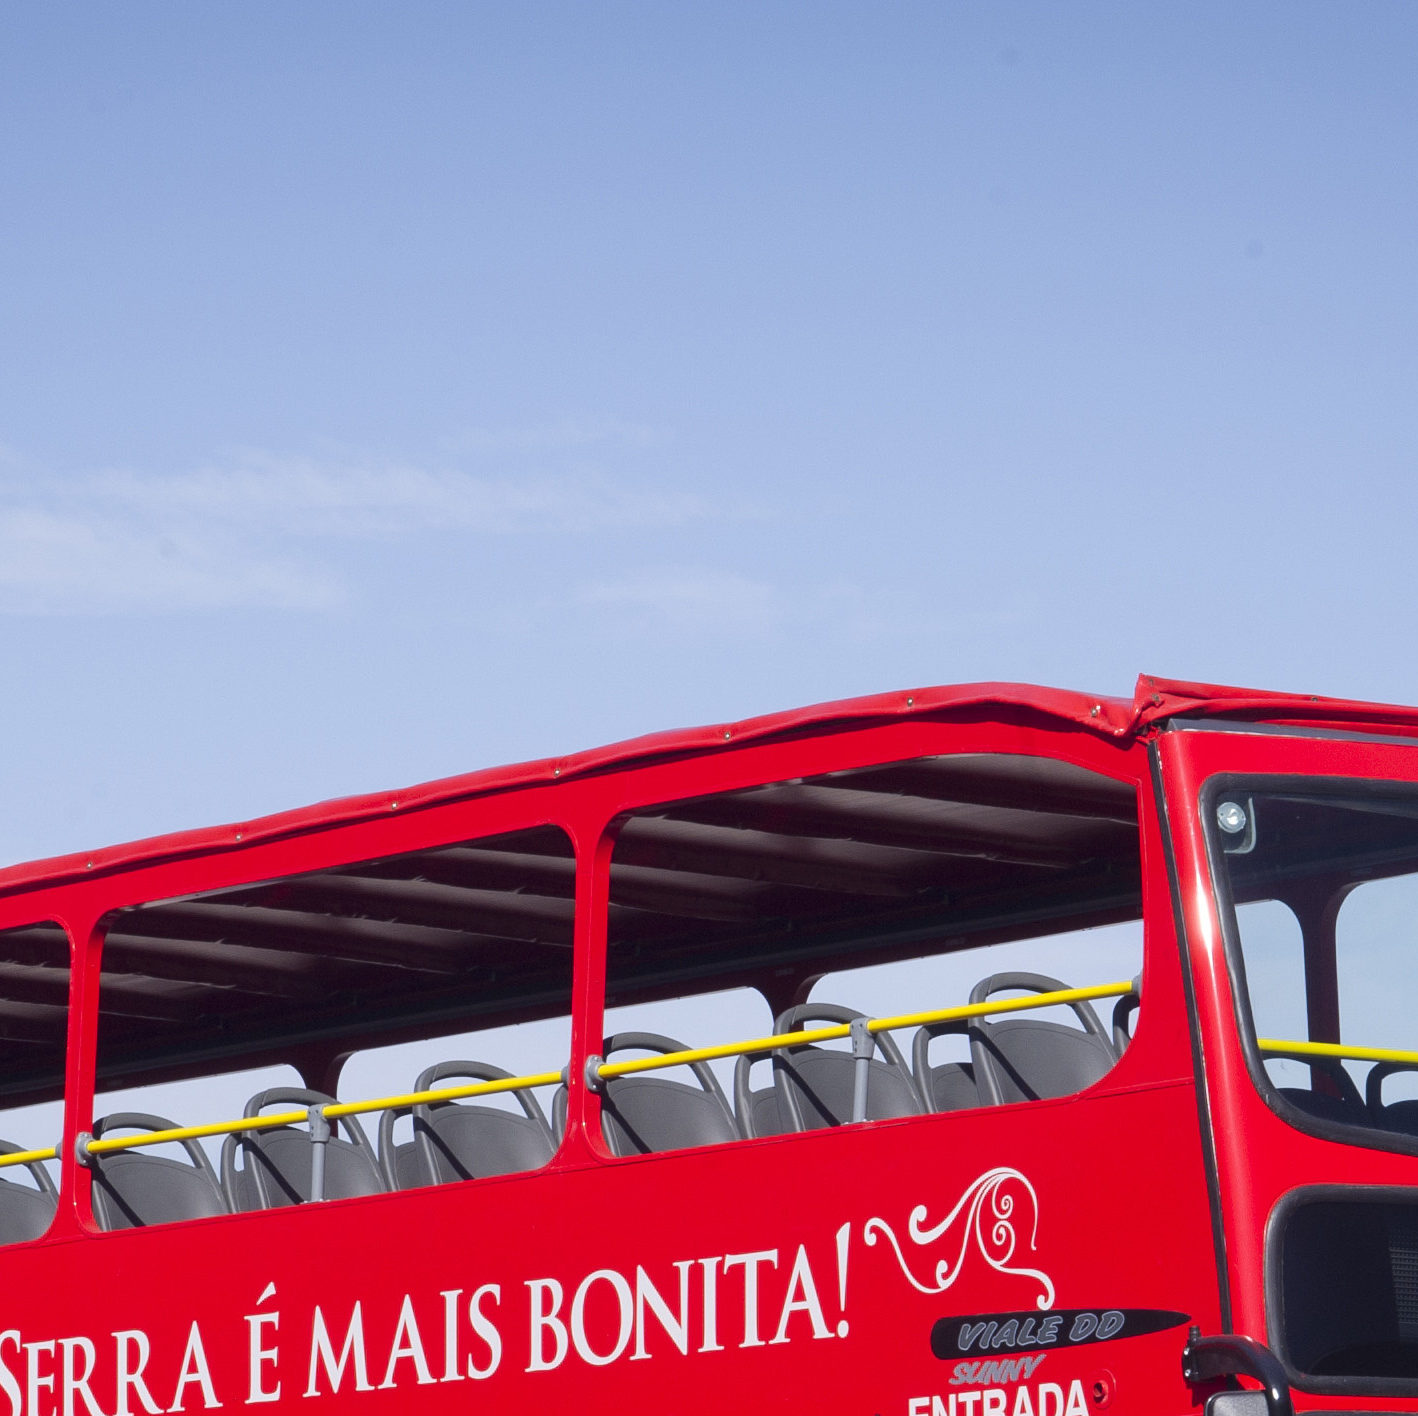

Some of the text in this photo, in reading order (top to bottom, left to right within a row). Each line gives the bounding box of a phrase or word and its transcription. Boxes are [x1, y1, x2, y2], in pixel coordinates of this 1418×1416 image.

[243, 1281, 281, 1405] É
[302, 1283, 502, 1398] MAIS
[523, 1221, 851, 1373] BONITA!
[957, 1310, 1126, 1351] VIALE DD
[948, 1353, 1048, 1386] SUNNY
